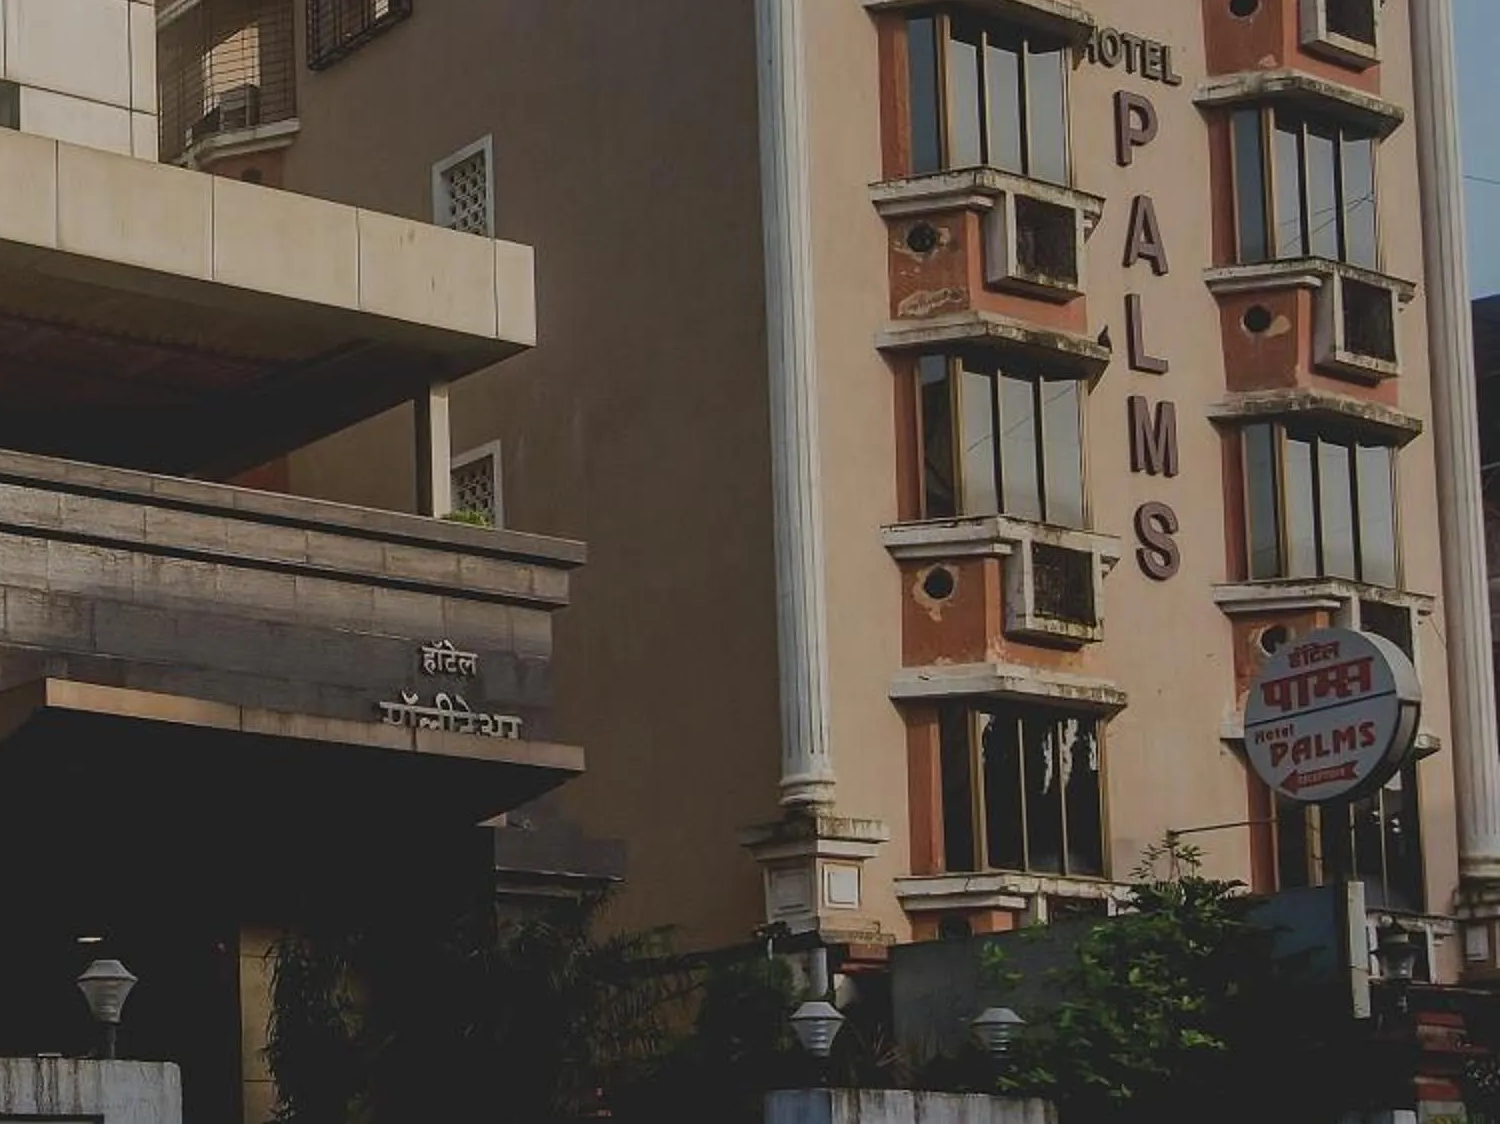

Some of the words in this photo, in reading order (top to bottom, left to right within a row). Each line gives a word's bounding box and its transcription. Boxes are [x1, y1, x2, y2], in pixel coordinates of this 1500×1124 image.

[1113, 89, 1181, 581] PALMS
[421, 639, 479, 674] हॉटेल
[1260, 657, 1374, 712] पाम्स
[1270, 722, 1376, 768] PALMS
